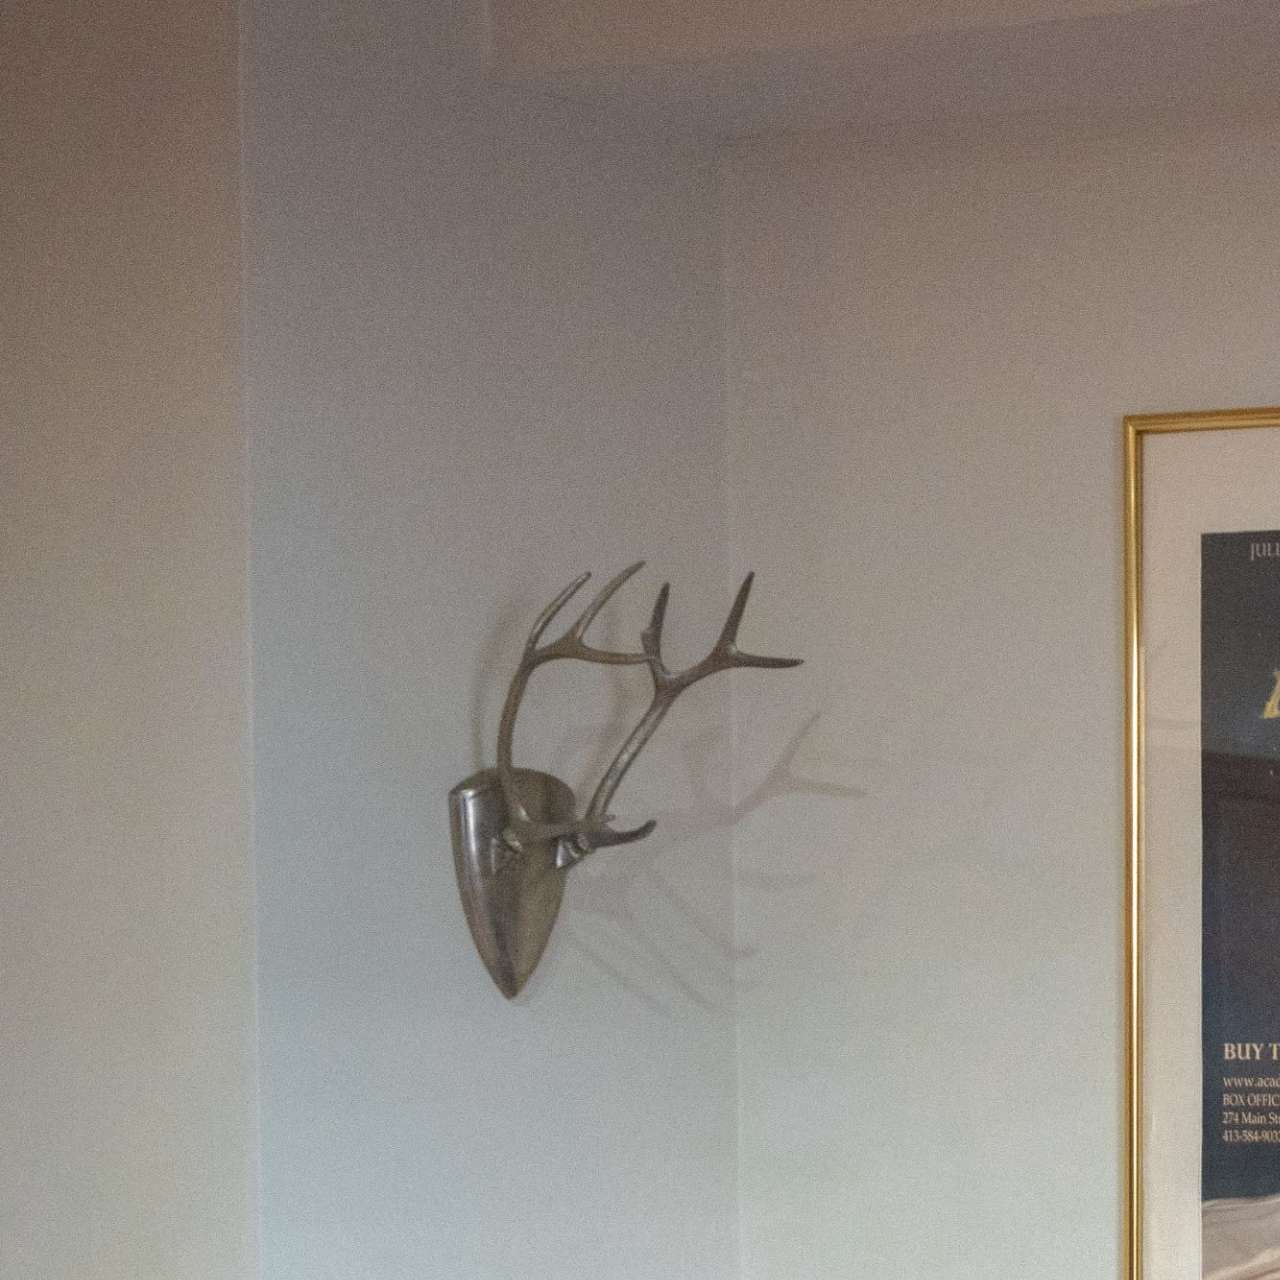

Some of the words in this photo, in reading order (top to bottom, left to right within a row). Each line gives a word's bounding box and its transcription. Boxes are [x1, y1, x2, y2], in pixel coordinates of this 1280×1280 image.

[1223, 1042, 1264, 1060] BUY
[1222, 1094, 1245, 1108] BOX
[1241, 1112, 1267, 1126] Main
